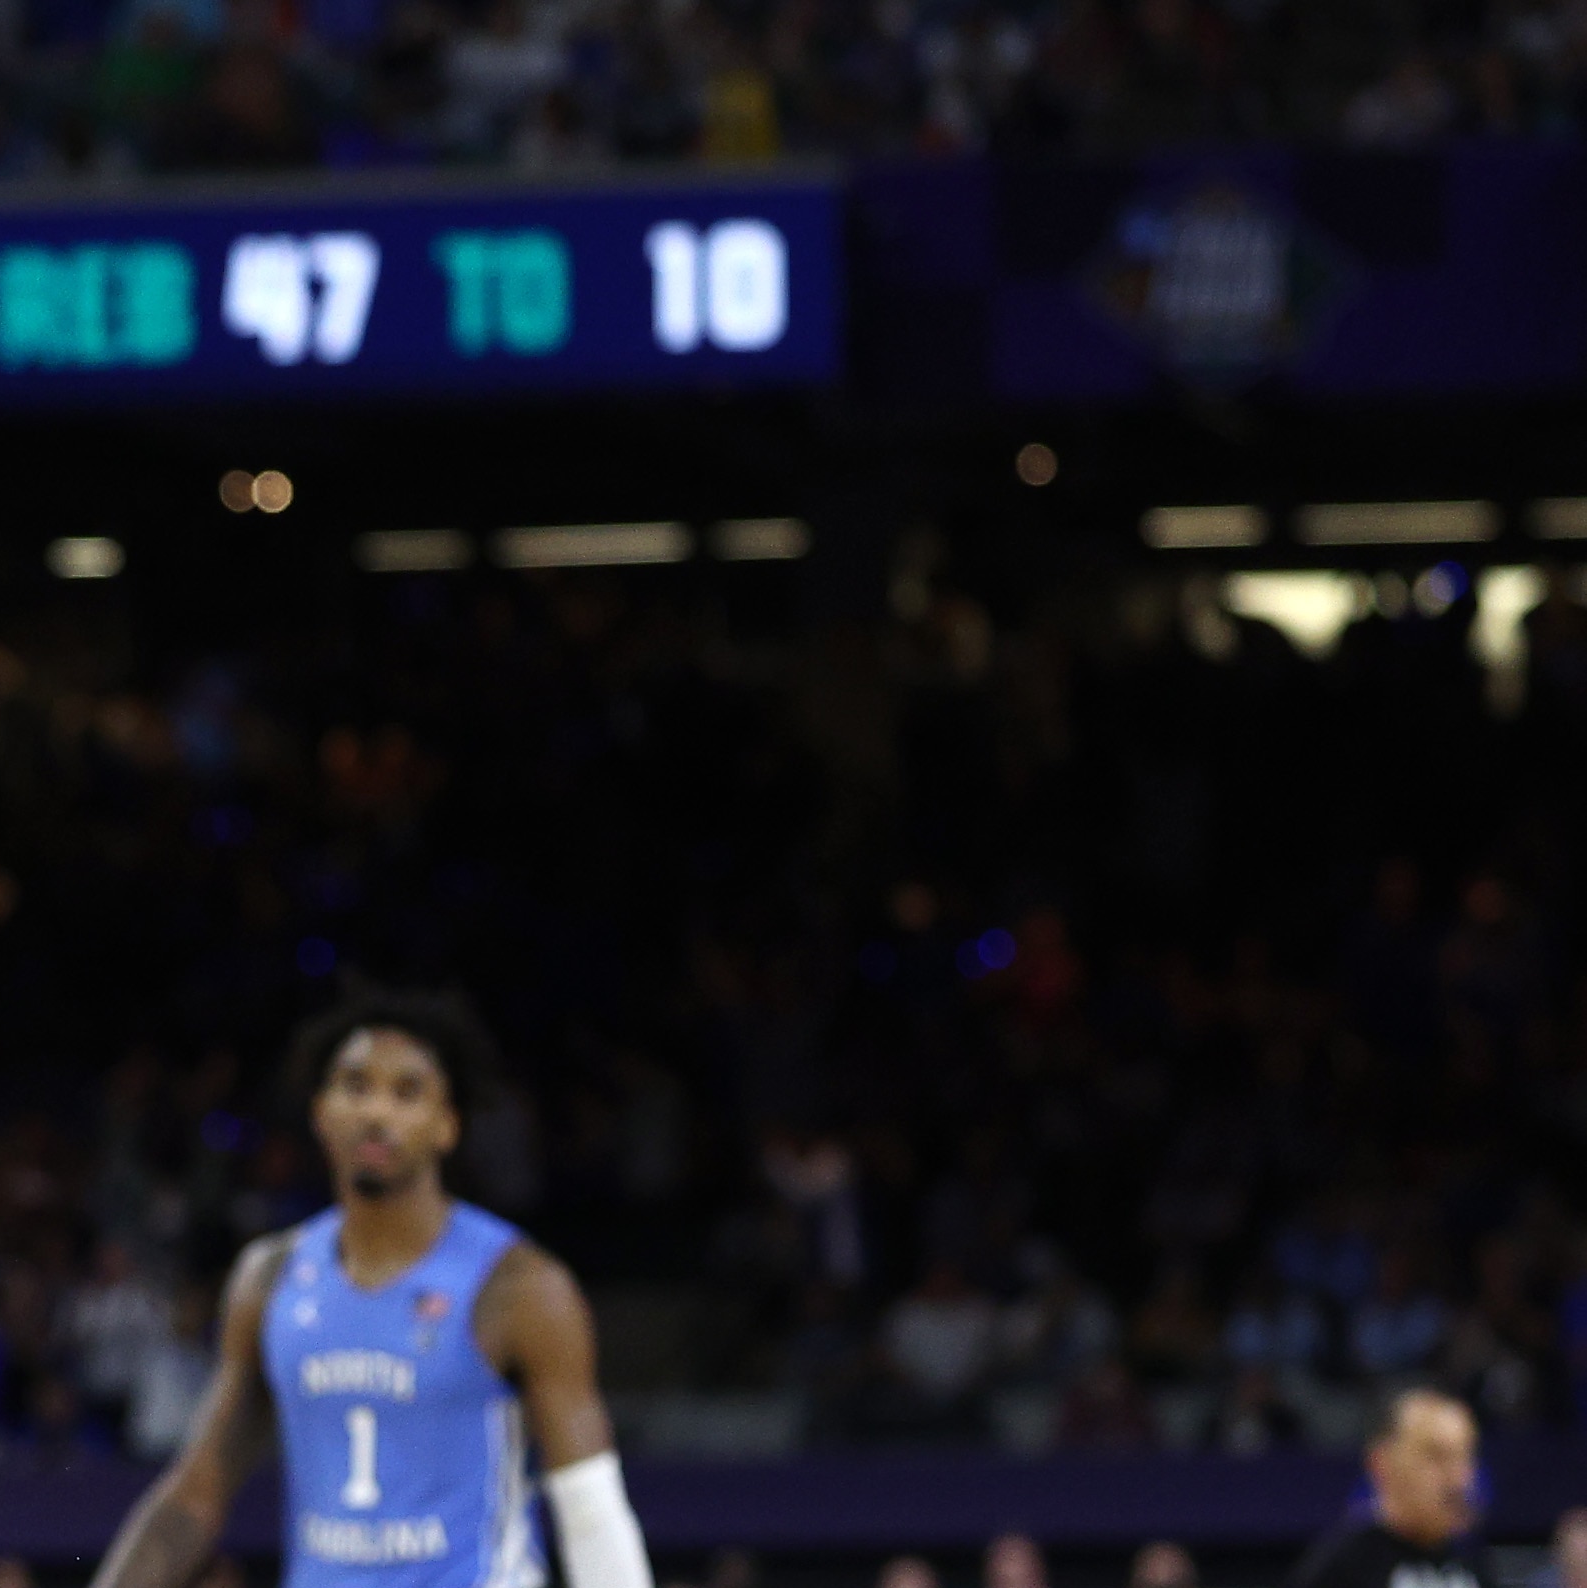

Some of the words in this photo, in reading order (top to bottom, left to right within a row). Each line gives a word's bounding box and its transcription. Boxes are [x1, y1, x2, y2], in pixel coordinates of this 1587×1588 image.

[224, 234, 378, 363] 47
[433, 231, 570, 355] TO
[645, 219, 787, 353] 10
[343, 1403, 381, 1510] 1
